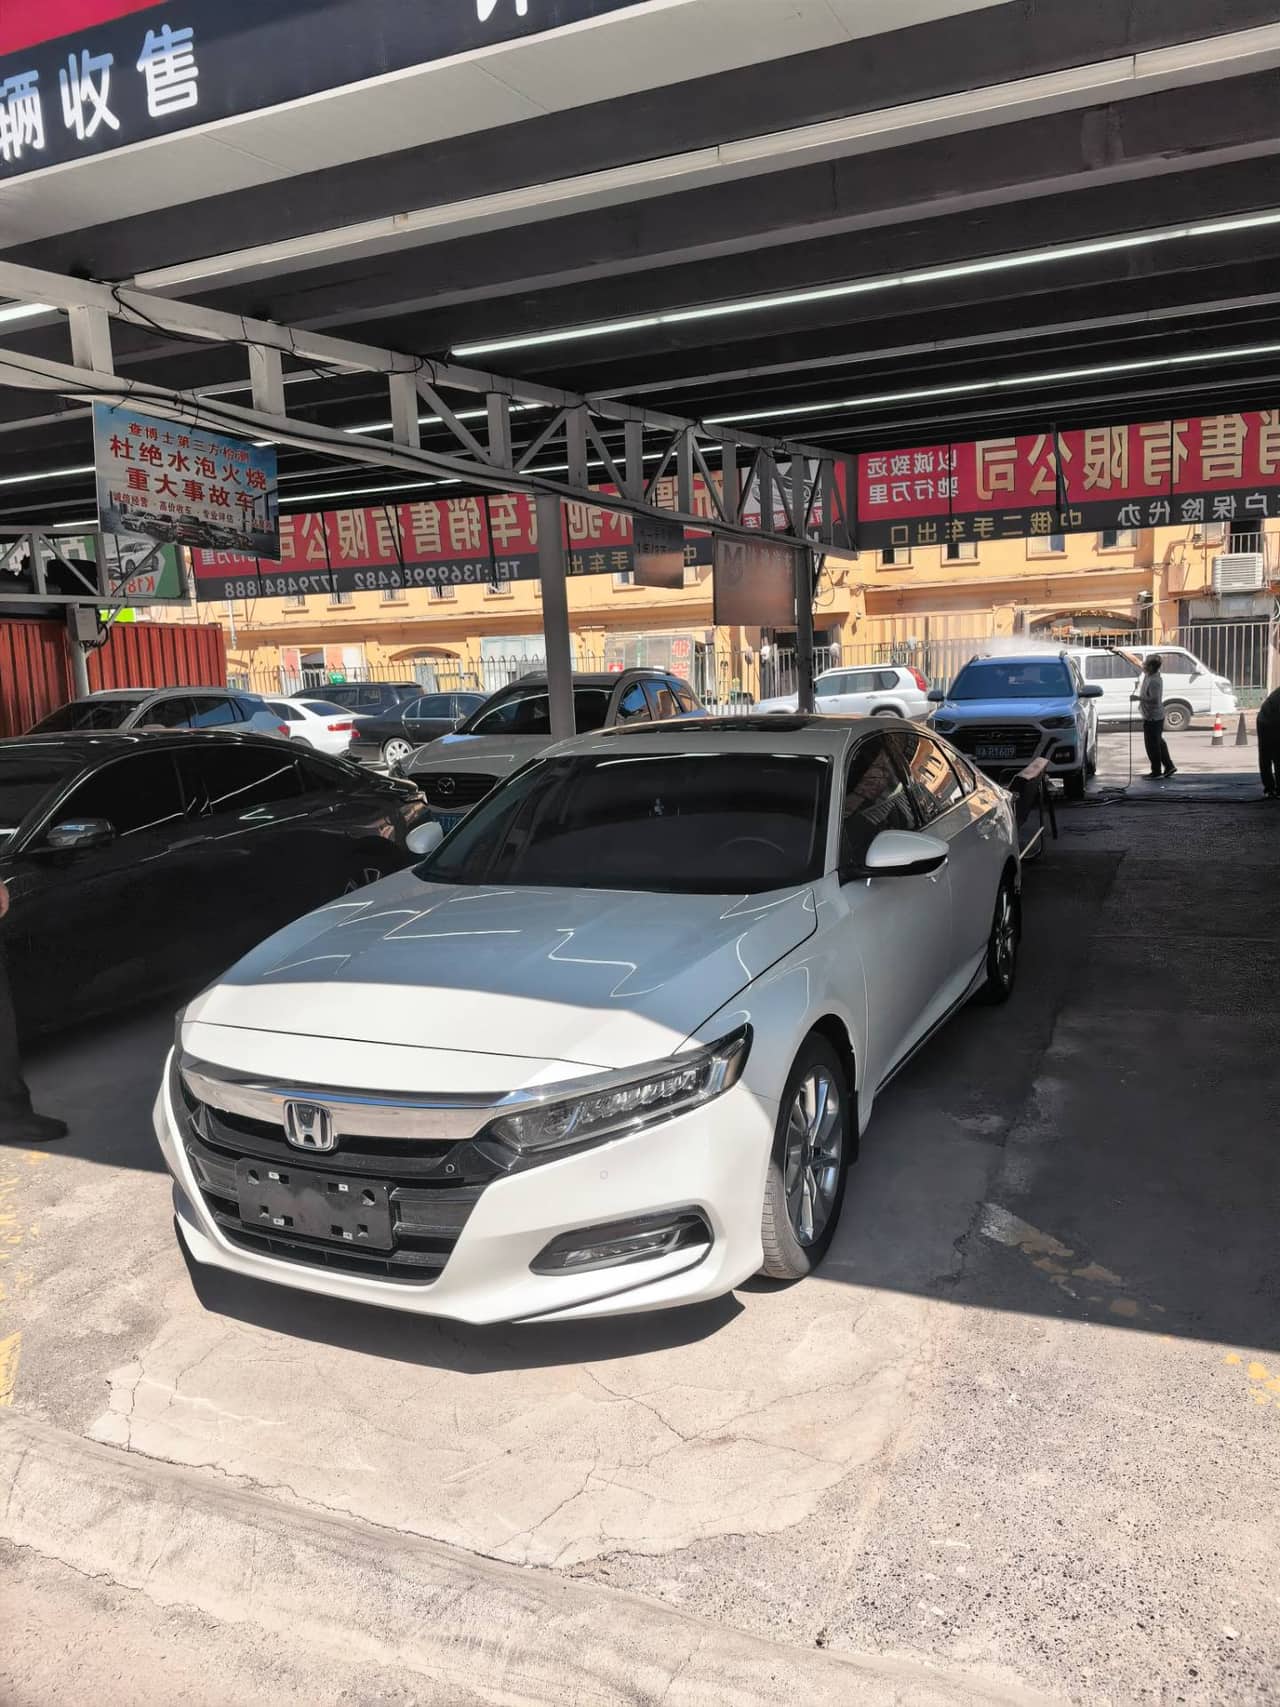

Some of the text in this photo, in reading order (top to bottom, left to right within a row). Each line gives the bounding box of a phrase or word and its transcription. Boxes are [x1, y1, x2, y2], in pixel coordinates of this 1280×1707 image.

[0, 24, 200, 162] 辆收售
[110, 434, 267, 491] 杜绝水泡火烧
[125, 467, 255, 512] 重大事故车
